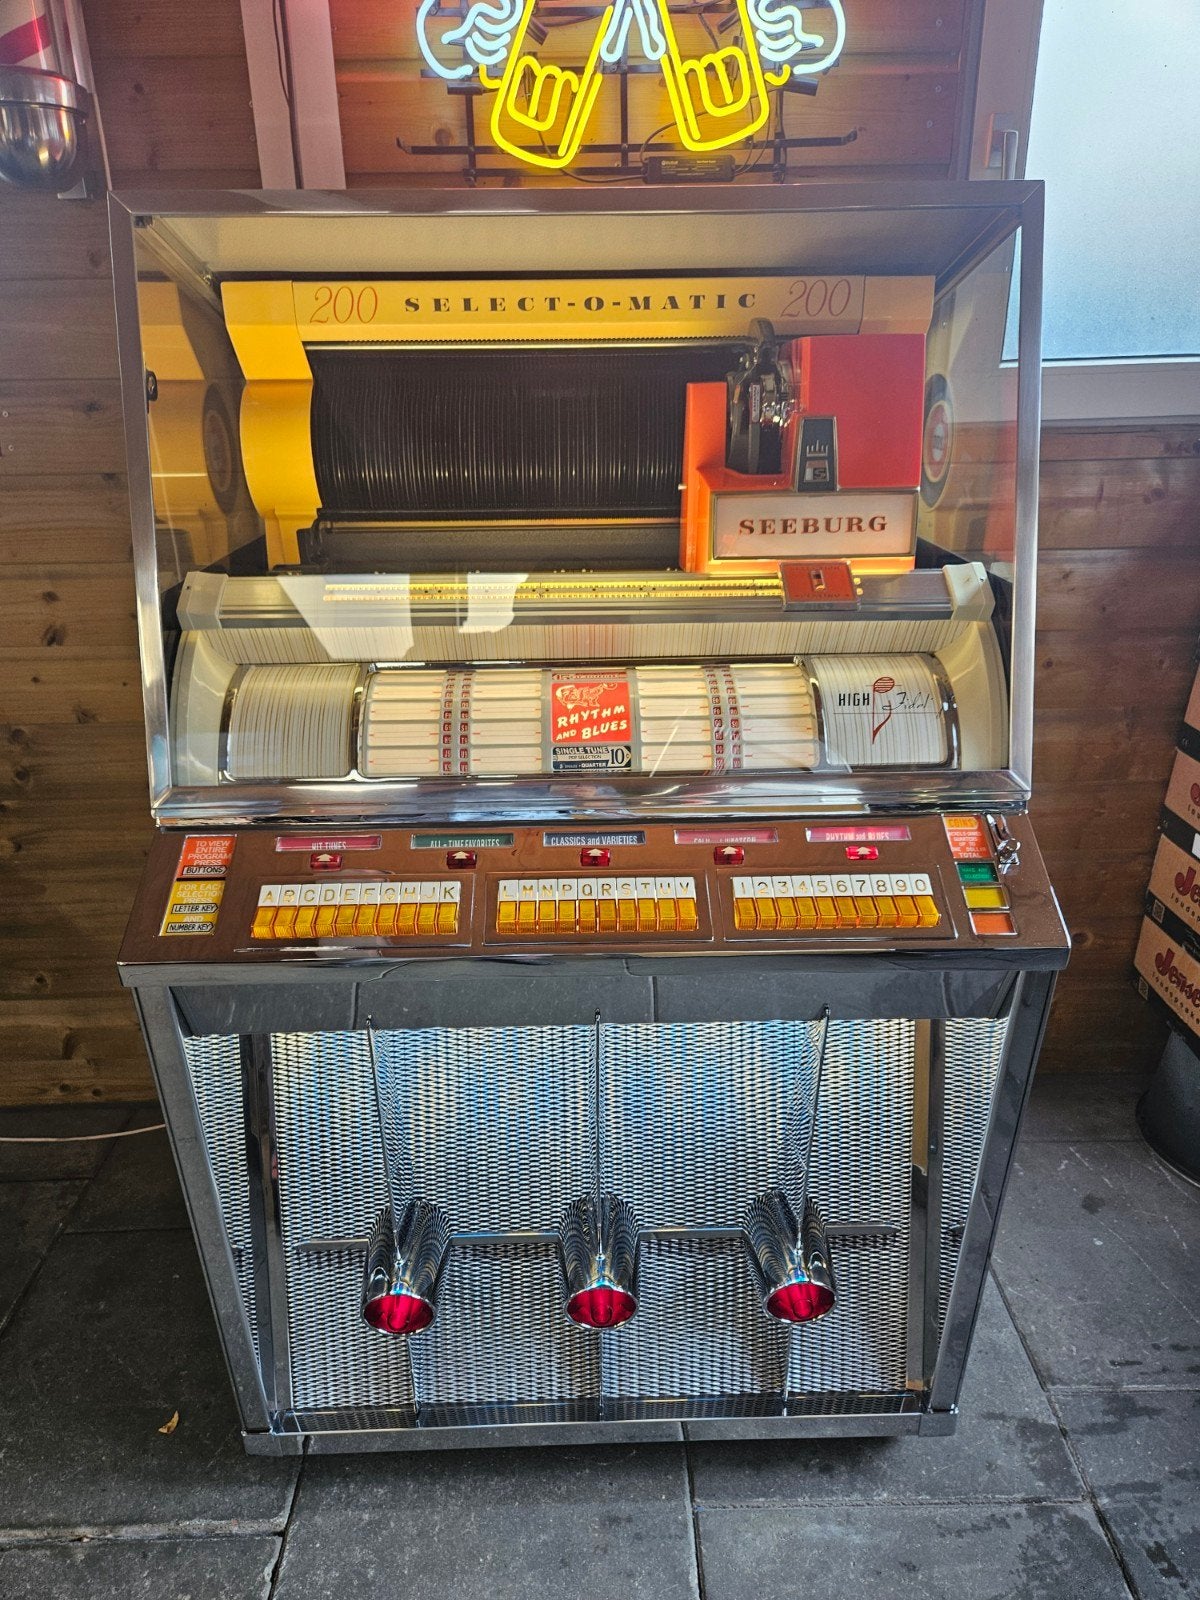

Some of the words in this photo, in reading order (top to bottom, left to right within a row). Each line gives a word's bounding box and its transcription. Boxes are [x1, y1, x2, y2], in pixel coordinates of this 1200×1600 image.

[310, 286, 378, 324] 200
[404, 294, 755, 312] SELECT-O-MATIC
[780, 279, 851, 317] 200
[739, 516, 887, 535] SEEBURG
[838, 693, 870, 706] HIGH
[557, 705, 625, 728] RHYTHM
[556, 729, 577, 740] AND
[581, 720, 627, 739] BLUES
[555, 747, 585, 755] SINGLE
[586, 746, 609, 754] TUNE
[610, 748, 625, 765] 10
[551, 836, 586, 846] CLASSICS
[587, 837, 600, 845] and
[601, 835, 638, 845] VARIETIES
[186, 866, 223, 874] BUTTONS
[262, 890, 274, 903] A
[283, 890, 295, 902] B
[303, 889, 315, 902] C
[323, 889, 335, 901] D
[343, 888, 355, 901] E
[363, 888, 375, 900] F
[382, 888, 395, 900] G
[403, 887, 416, 900] H
[424, 887, 435, 899] J
[443, 886, 455, 899] K
[503, 886, 514, 899] L
[521, 886, 534, 898] M
[541, 885, 553, 897] N
[562, 884, 572, 897] P
[582, 884, 593, 897] Q
[601, 884, 612, 896] R
[621, 883, 631, 896] S
[640, 883, 651, 895] T
[660, 883, 671, 895] U
[679, 882, 689, 894] V
[740, 882, 745, 894] 1
[757, 882, 769, 894] 2
[777, 881, 789, 894] 3
[798, 881, 808, 893] 4
[817, 881, 828, 893] 5
[836, 880, 847, 893] 6
[856, 880, 866, 892] 7
[876, 879, 887, 892] 8
[895, 879, 907, 892] 9
[915, 879, 926, 892] 0
